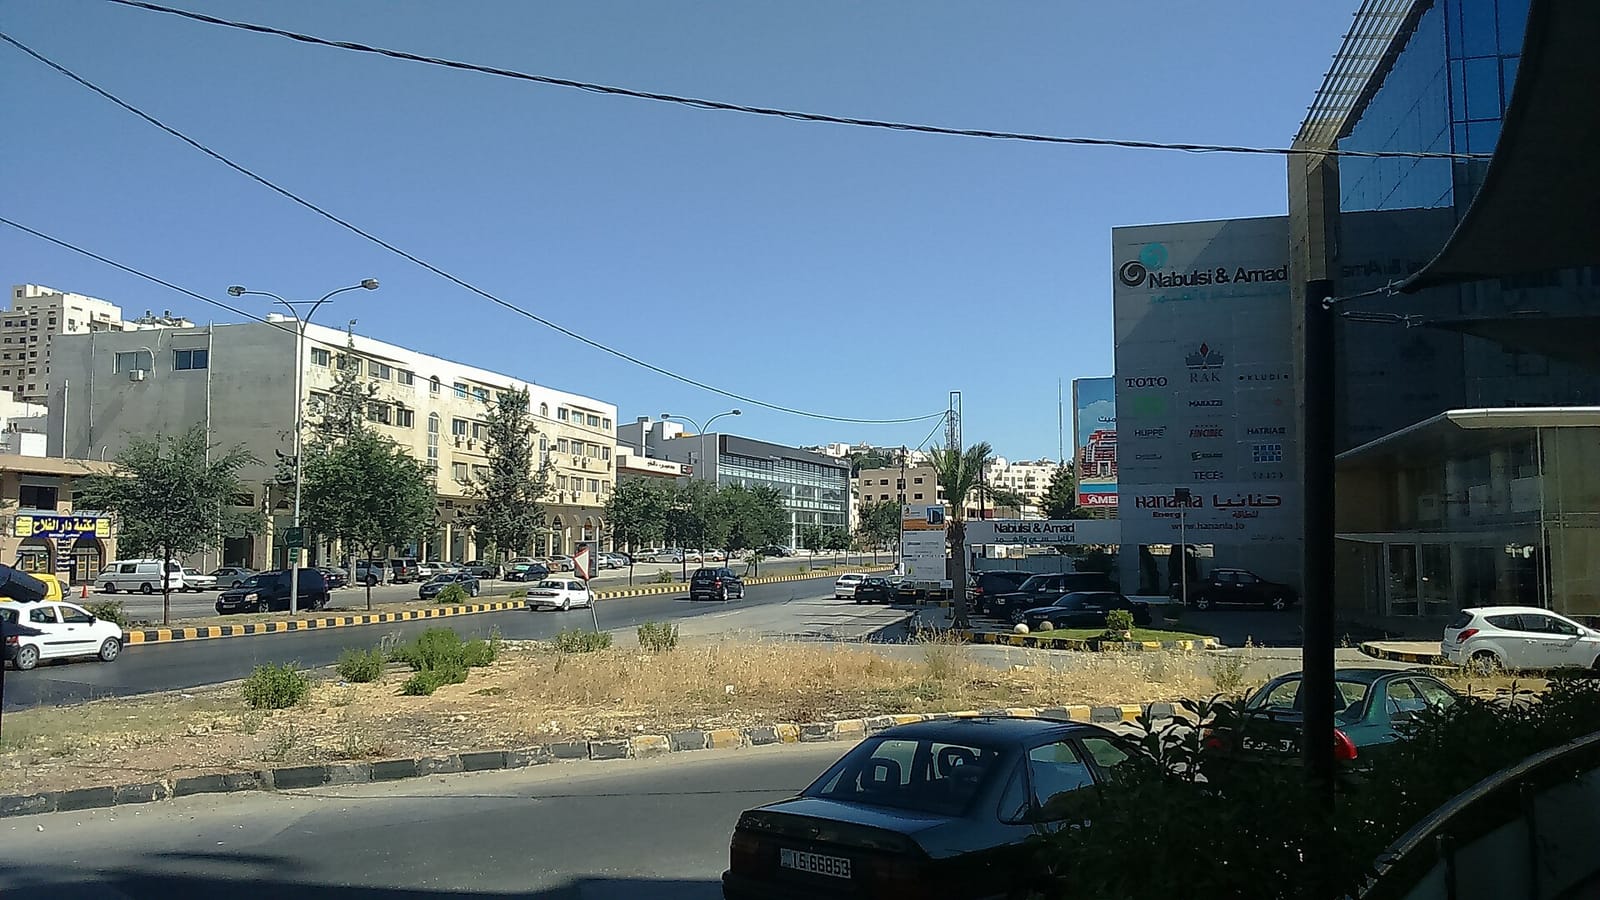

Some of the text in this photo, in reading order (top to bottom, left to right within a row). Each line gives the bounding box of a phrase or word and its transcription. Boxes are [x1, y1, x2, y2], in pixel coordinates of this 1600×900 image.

[1149, 264, 1288, 288] Nabulsi & Amad
[1125, 376, 1168, 388] TOTO
[1189, 372, 1221, 383] RAK
[58, 519, 72, 534] دار
[73, 517, 96, 534] مكتبة
[994, 522, 1075, 533] Nabulsi & Amad
